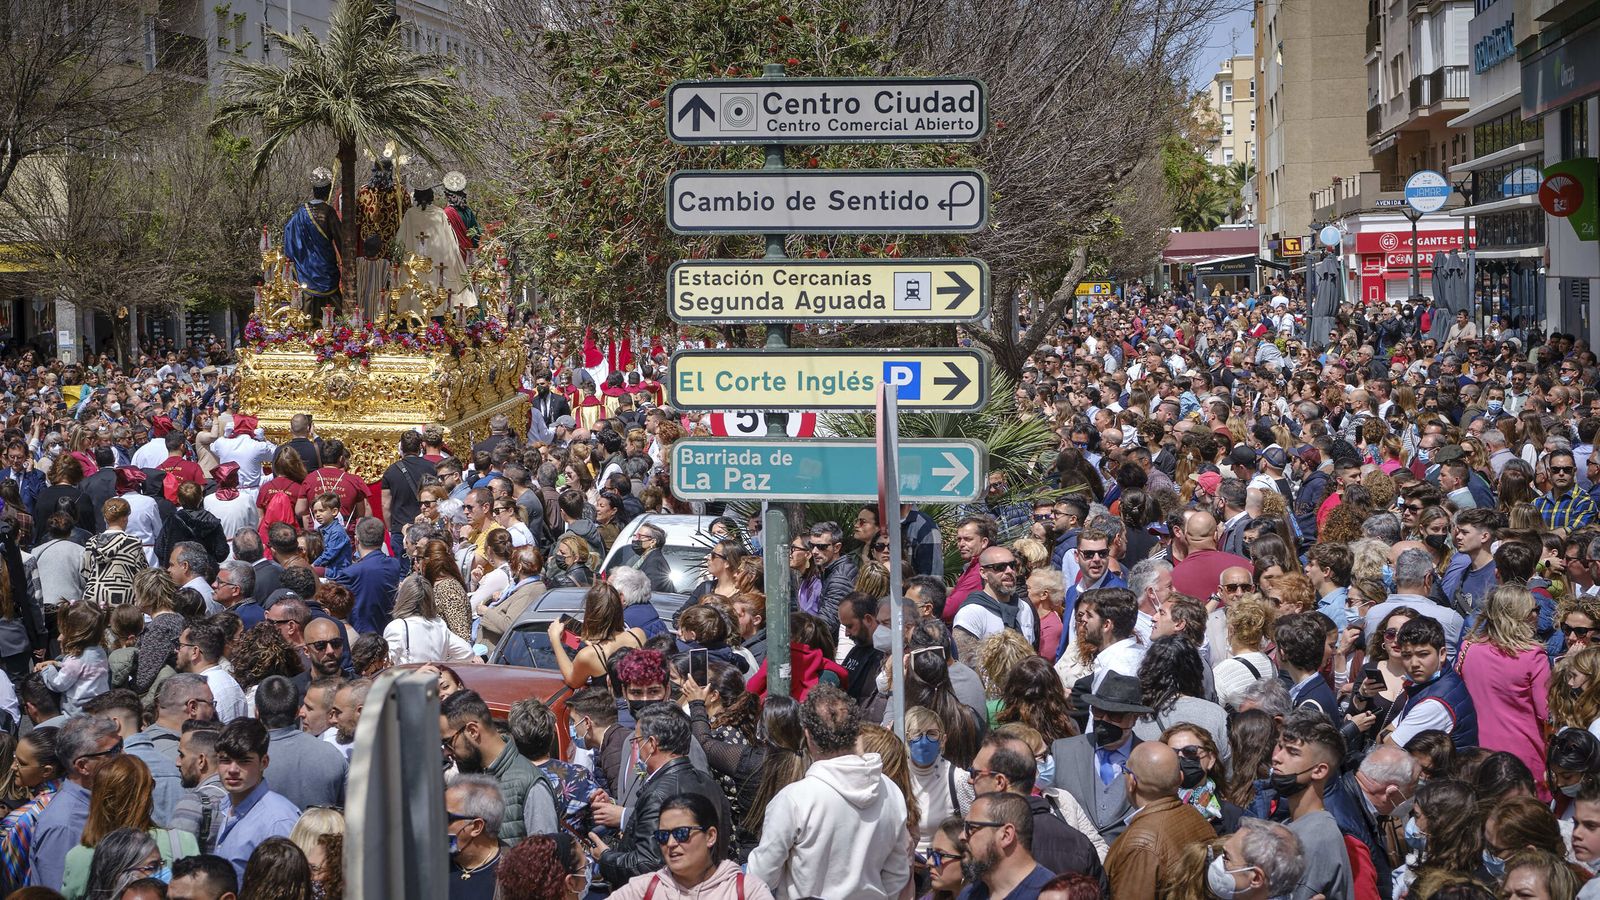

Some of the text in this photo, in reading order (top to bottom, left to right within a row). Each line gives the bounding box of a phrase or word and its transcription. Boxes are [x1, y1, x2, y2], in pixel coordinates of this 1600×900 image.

[763, 90, 975, 116] Centro Ciudad
[766, 116, 974, 132] Centro Comercial Abierto
[678, 189, 929, 212] Cambio de Sentido
[1414, 188, 1442, 197] JAMAR
[1408, 236, 1448, 246] GGANTE
[678, 269, 872, 286] Estación Cercanías
[679, 290, 886, 315] Segunda Aguada
[680, 366, 914, 395] El Corte Inglés P
[680, 448, 793, 466] Barriada de
[681, 468, 771, 491] La Paz
